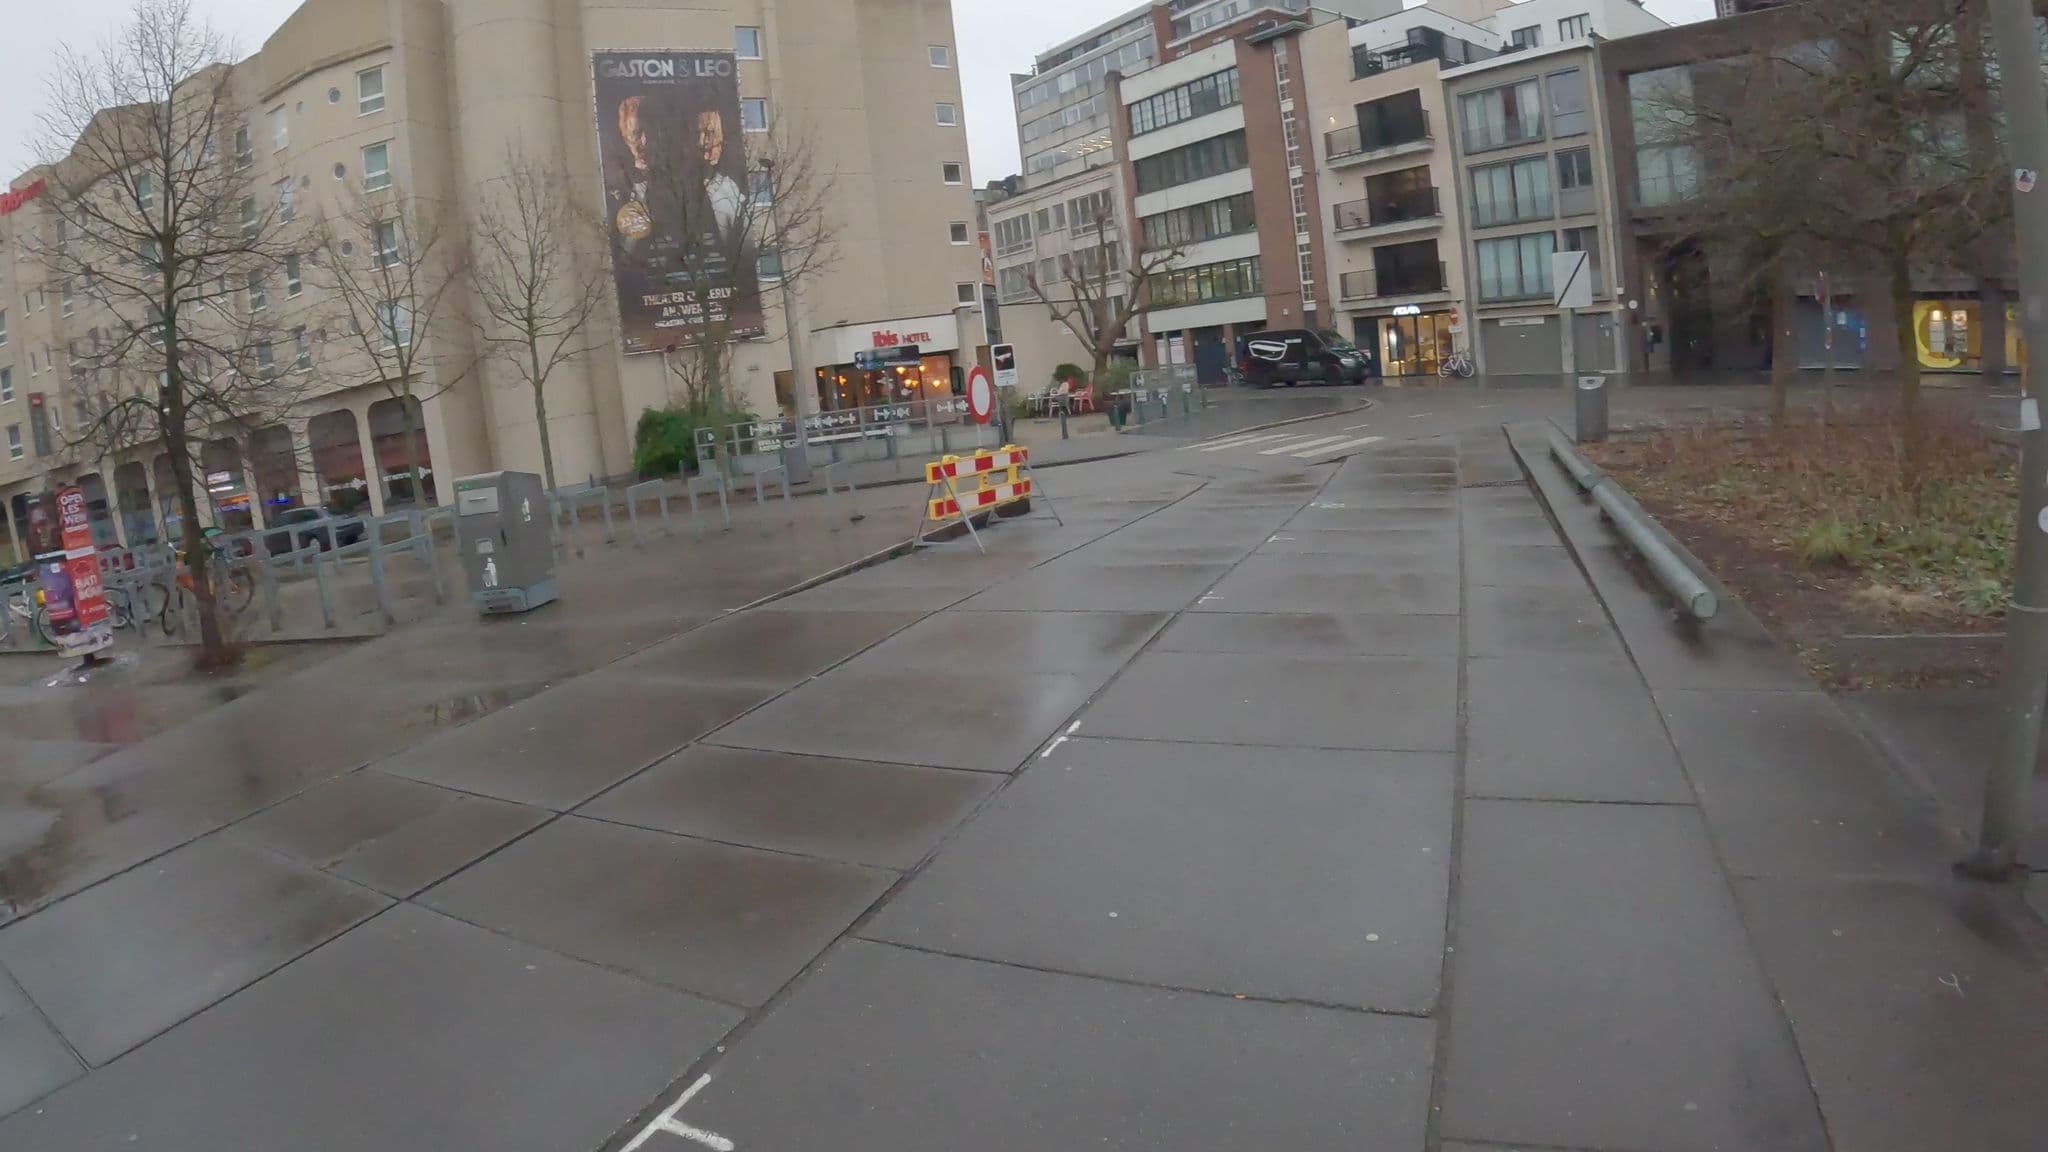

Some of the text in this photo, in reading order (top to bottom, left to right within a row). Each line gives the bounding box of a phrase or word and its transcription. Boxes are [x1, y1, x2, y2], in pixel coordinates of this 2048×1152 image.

[601, 59, 674, 77] GASTON
[695, 58, 731, 76] LEO
[872, 329, 932, 347] ibis HOTEL
